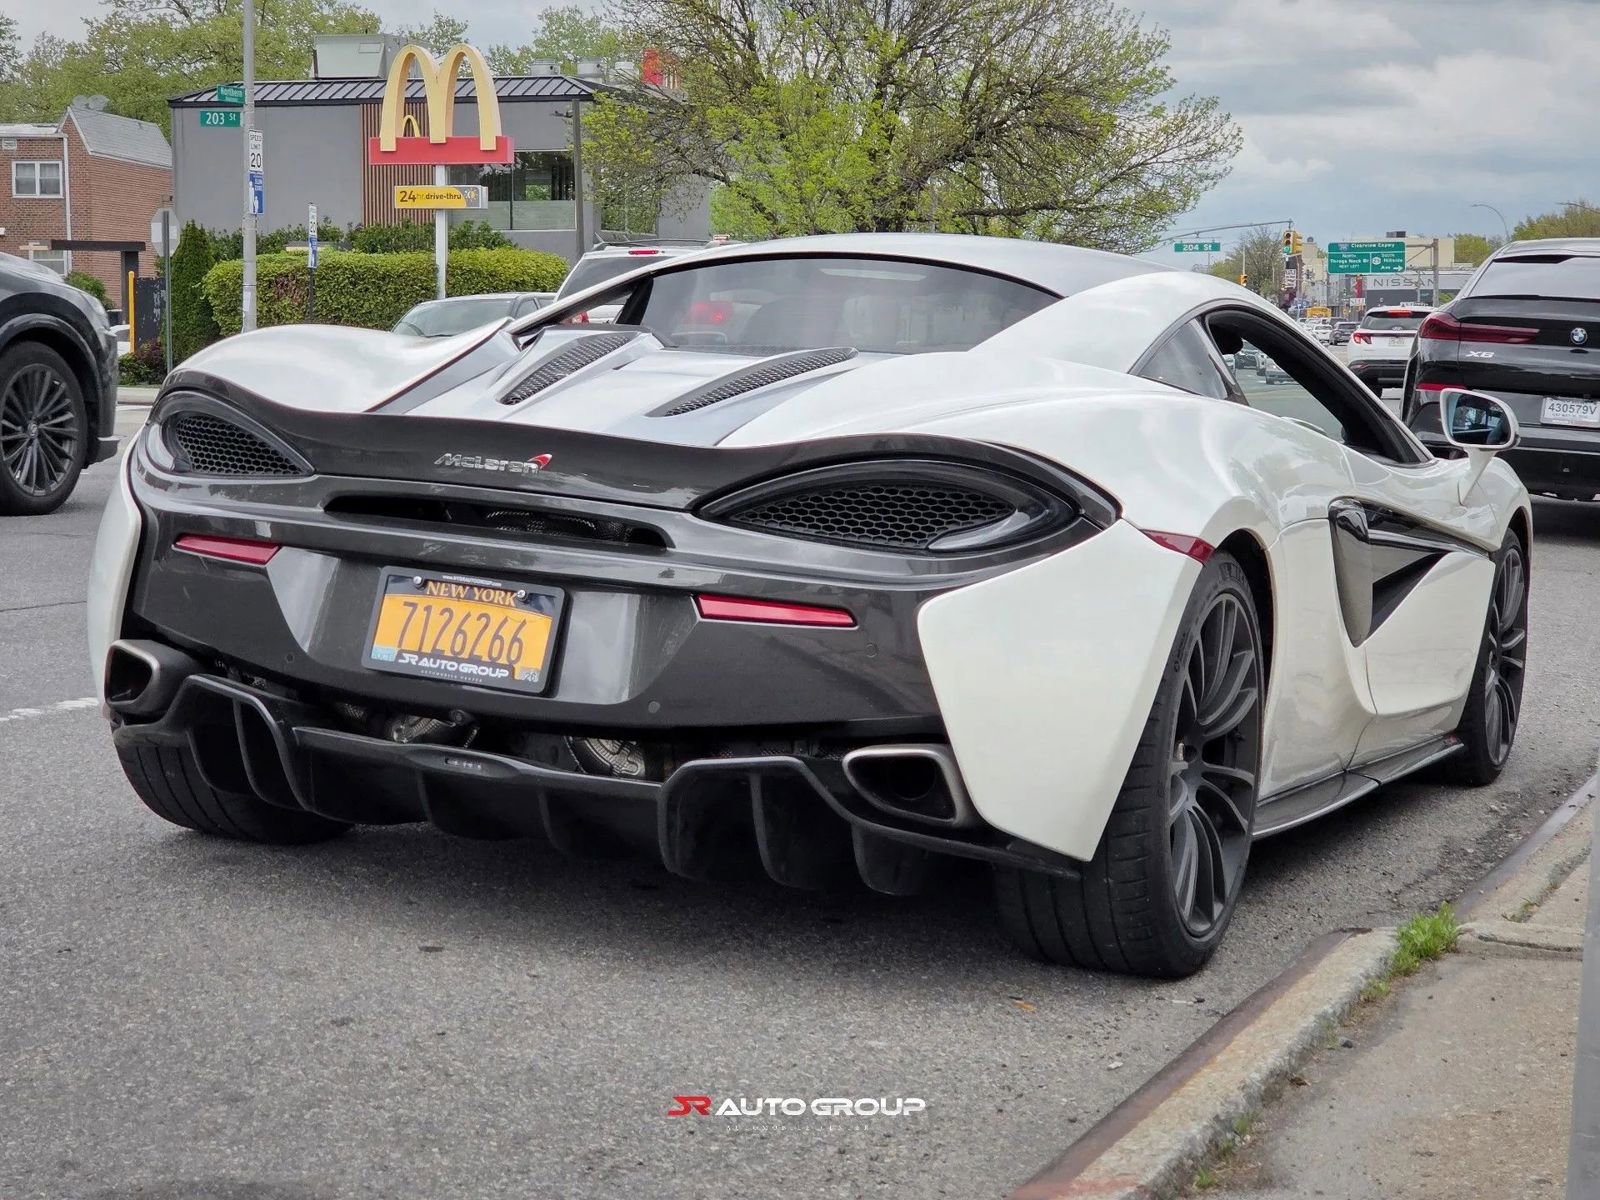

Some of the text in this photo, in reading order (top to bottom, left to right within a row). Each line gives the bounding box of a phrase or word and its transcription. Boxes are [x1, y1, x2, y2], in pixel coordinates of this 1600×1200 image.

[206, 112, 236, 125] 203 St
[250, 152, 262, 168] 20
[400, 190, 416, 203] 24
[1465, 350, 1495, 358] X6
[1548, 402, 1598, 415] 430579V
[434, 453, 538, 474] McLaren
[426, 581, 517, 608] NEW YORK
[397, 601, 527, 666] 7126266
[418, 656, 458, 672] AUTO
[459, 660, 509, 679] GROUP
